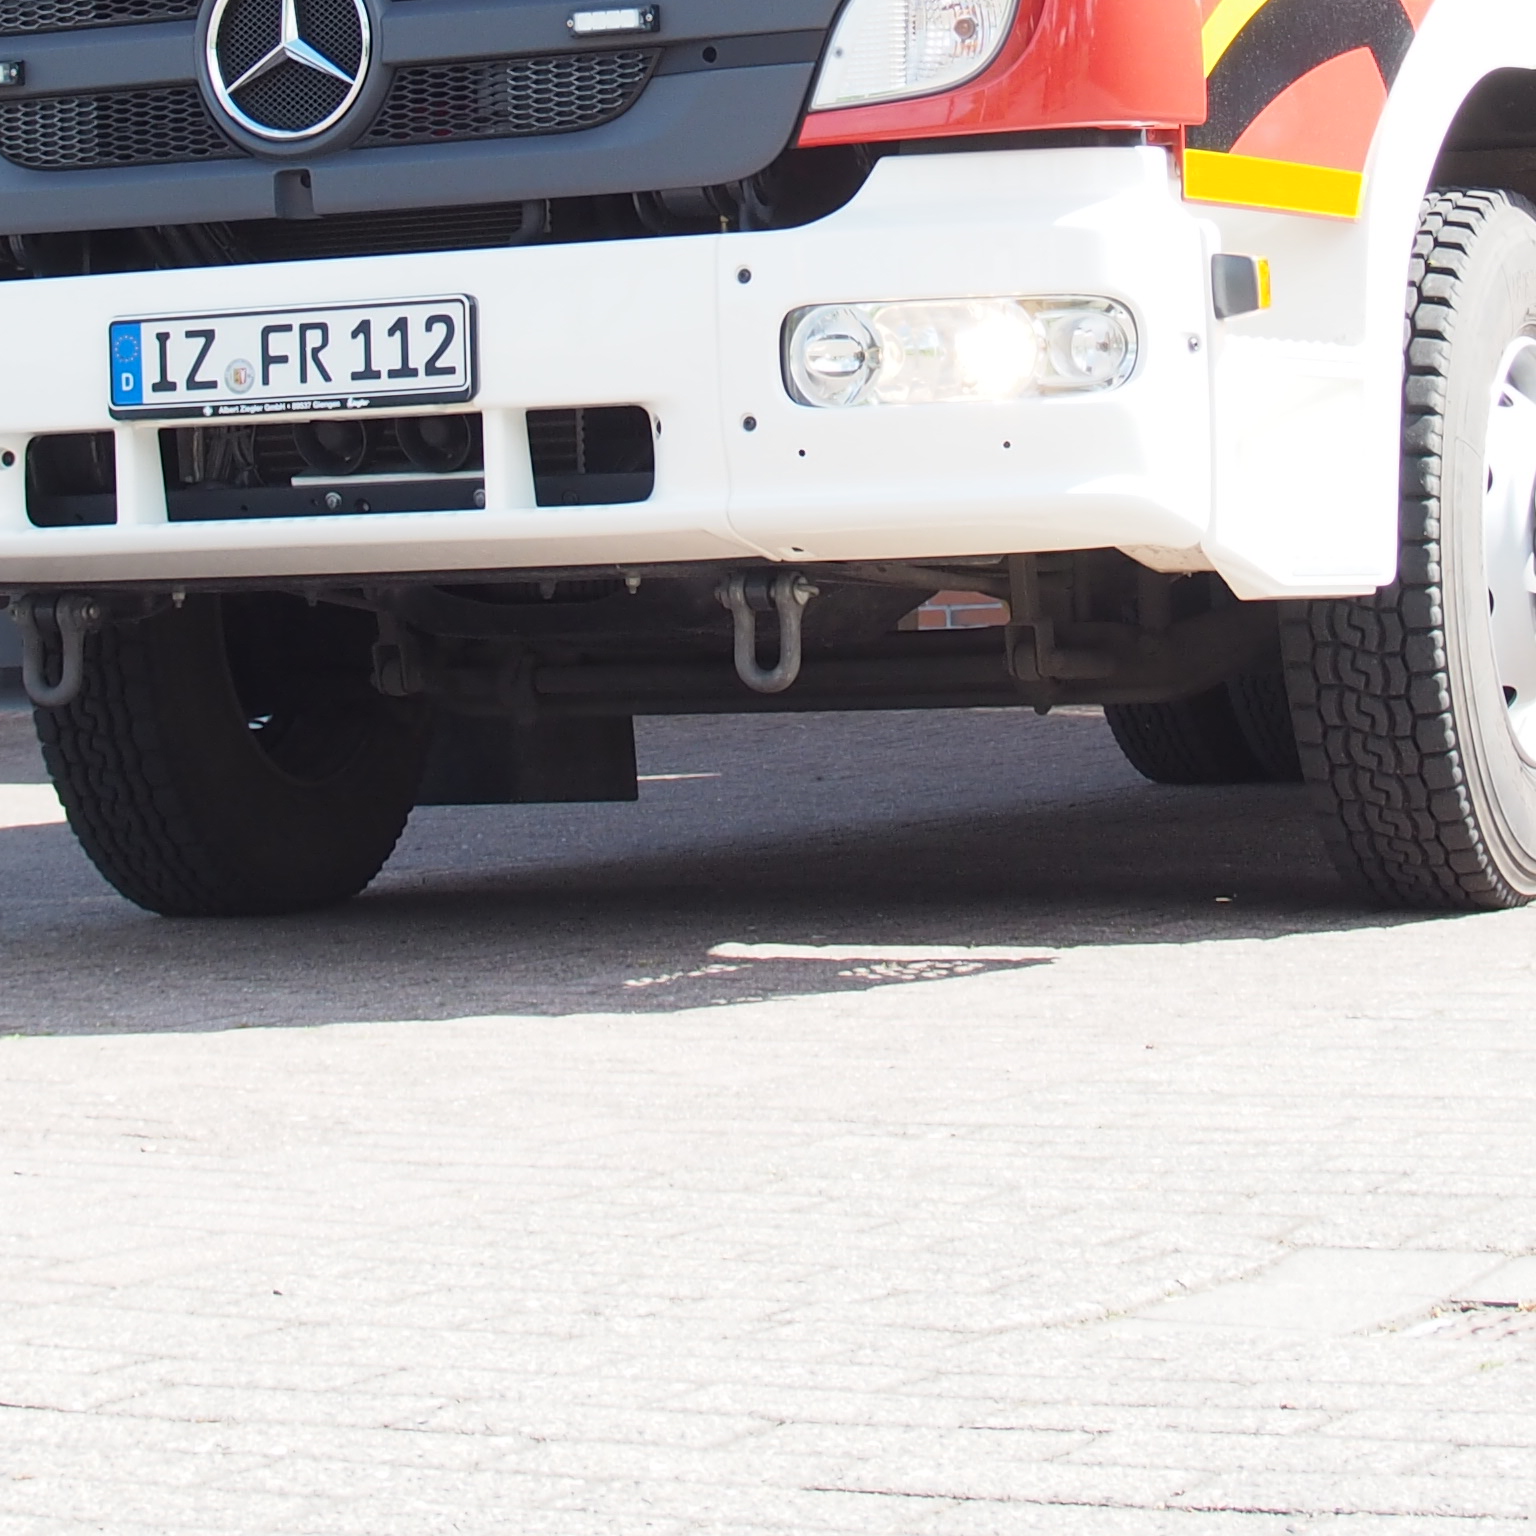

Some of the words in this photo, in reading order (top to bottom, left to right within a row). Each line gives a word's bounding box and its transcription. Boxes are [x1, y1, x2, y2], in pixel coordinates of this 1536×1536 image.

[151, 328, 219, 393] IZ
[260, 322, 333, 387] FR
[350, 314, 458, 381] 112
[121, 372, 135, 392] D
